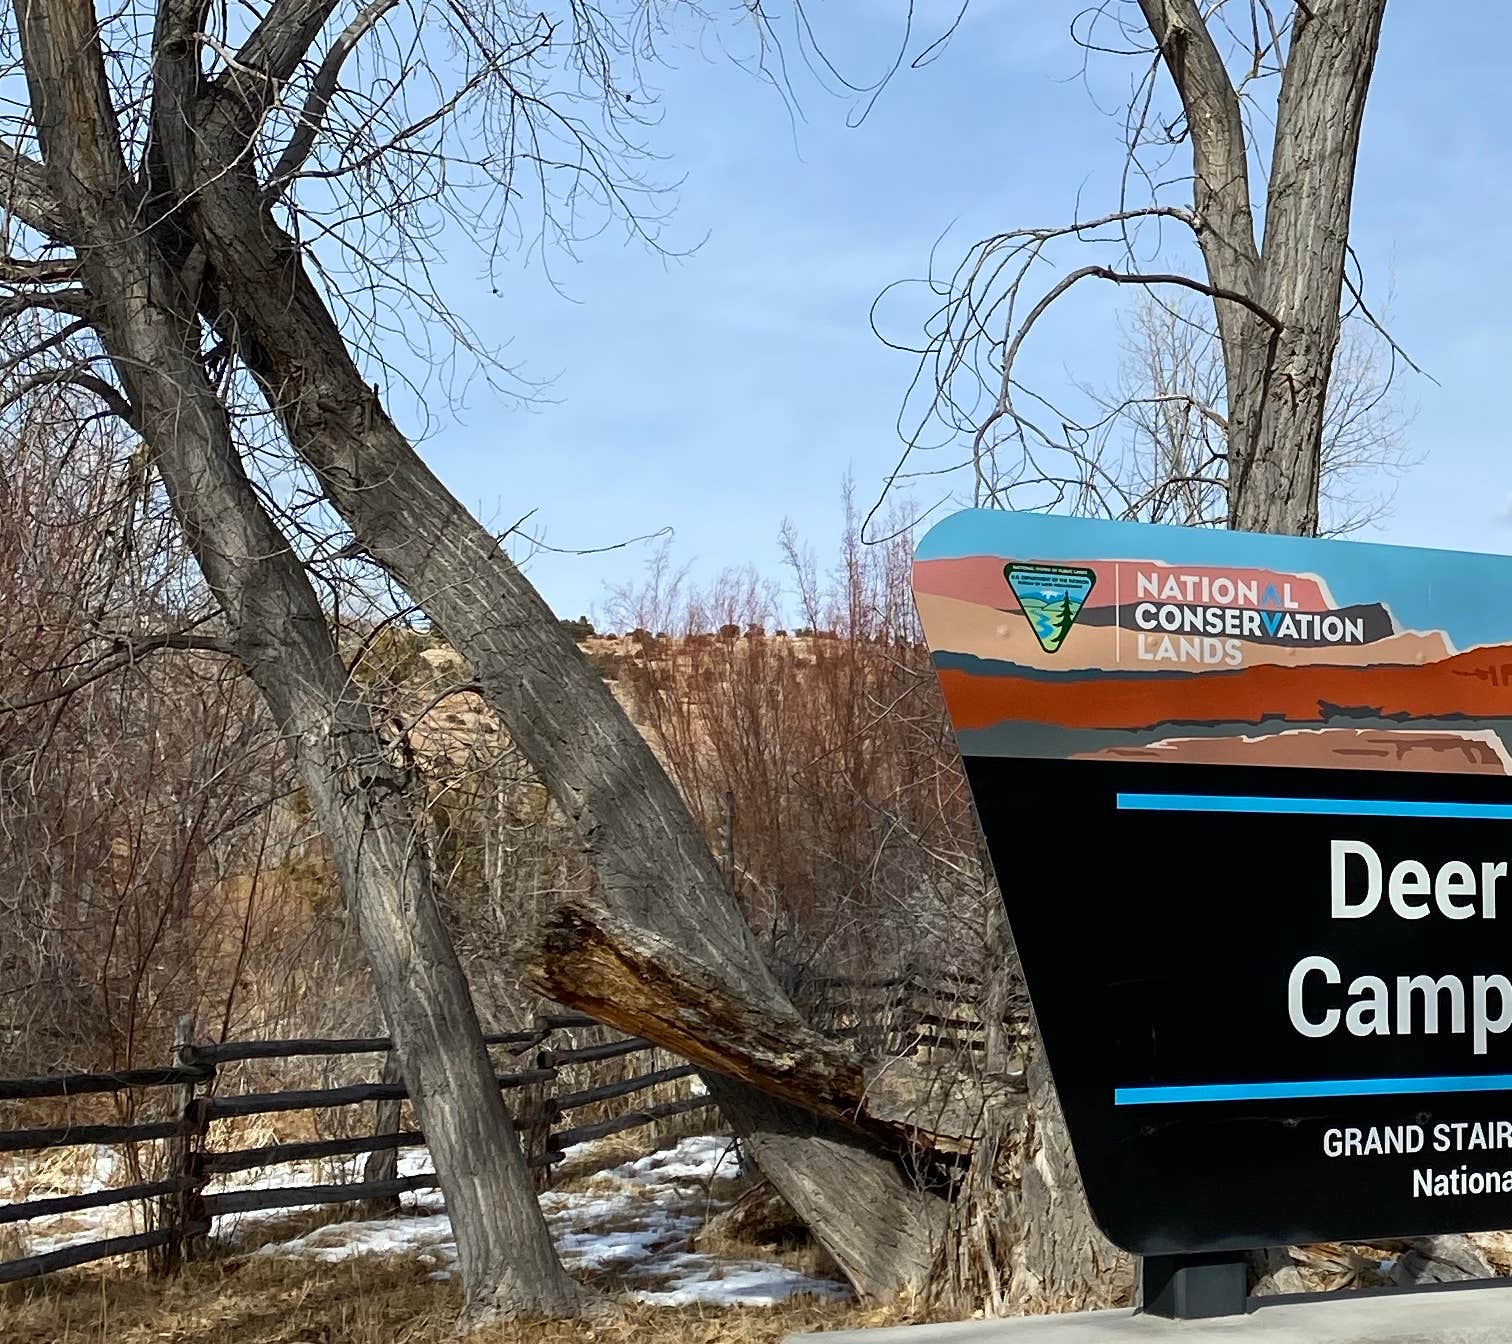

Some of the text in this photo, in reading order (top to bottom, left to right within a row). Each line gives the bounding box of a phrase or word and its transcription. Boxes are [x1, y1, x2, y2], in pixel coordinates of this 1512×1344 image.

[1137, 571, 1298, 609] NATIONAL
[1135, 603, 1364, 643] CONSERVATION
[1138, 634, 1242, 665] LANDS
[1330, 839, 1508, 920] Deer
[1323, 1124, 1425, 1158] GRAND
